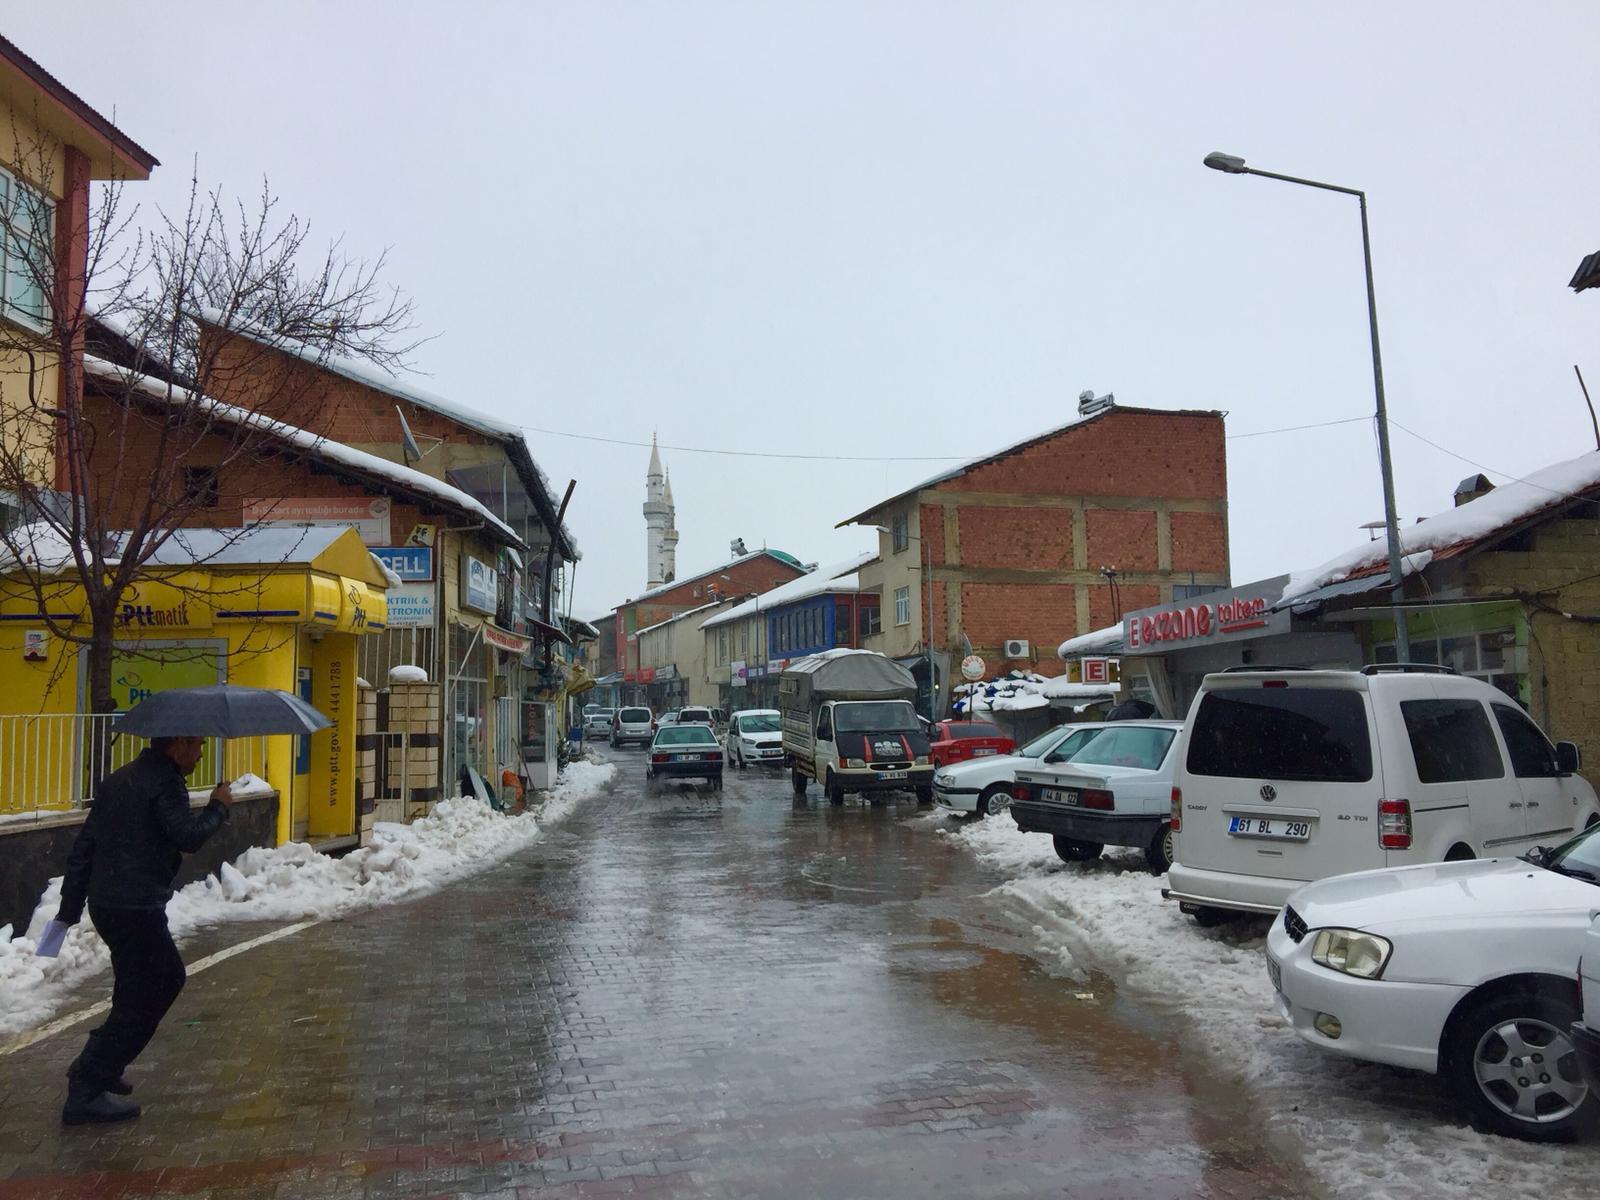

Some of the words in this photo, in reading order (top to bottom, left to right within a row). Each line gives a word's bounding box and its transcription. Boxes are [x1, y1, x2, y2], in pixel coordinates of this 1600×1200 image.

[1141, 603, 1212, 644] eczane
[1238, 820, 1251, 832] 61
[1258, 821, 1272, 834] BL
[1285, 822, 1309, 837] 290
